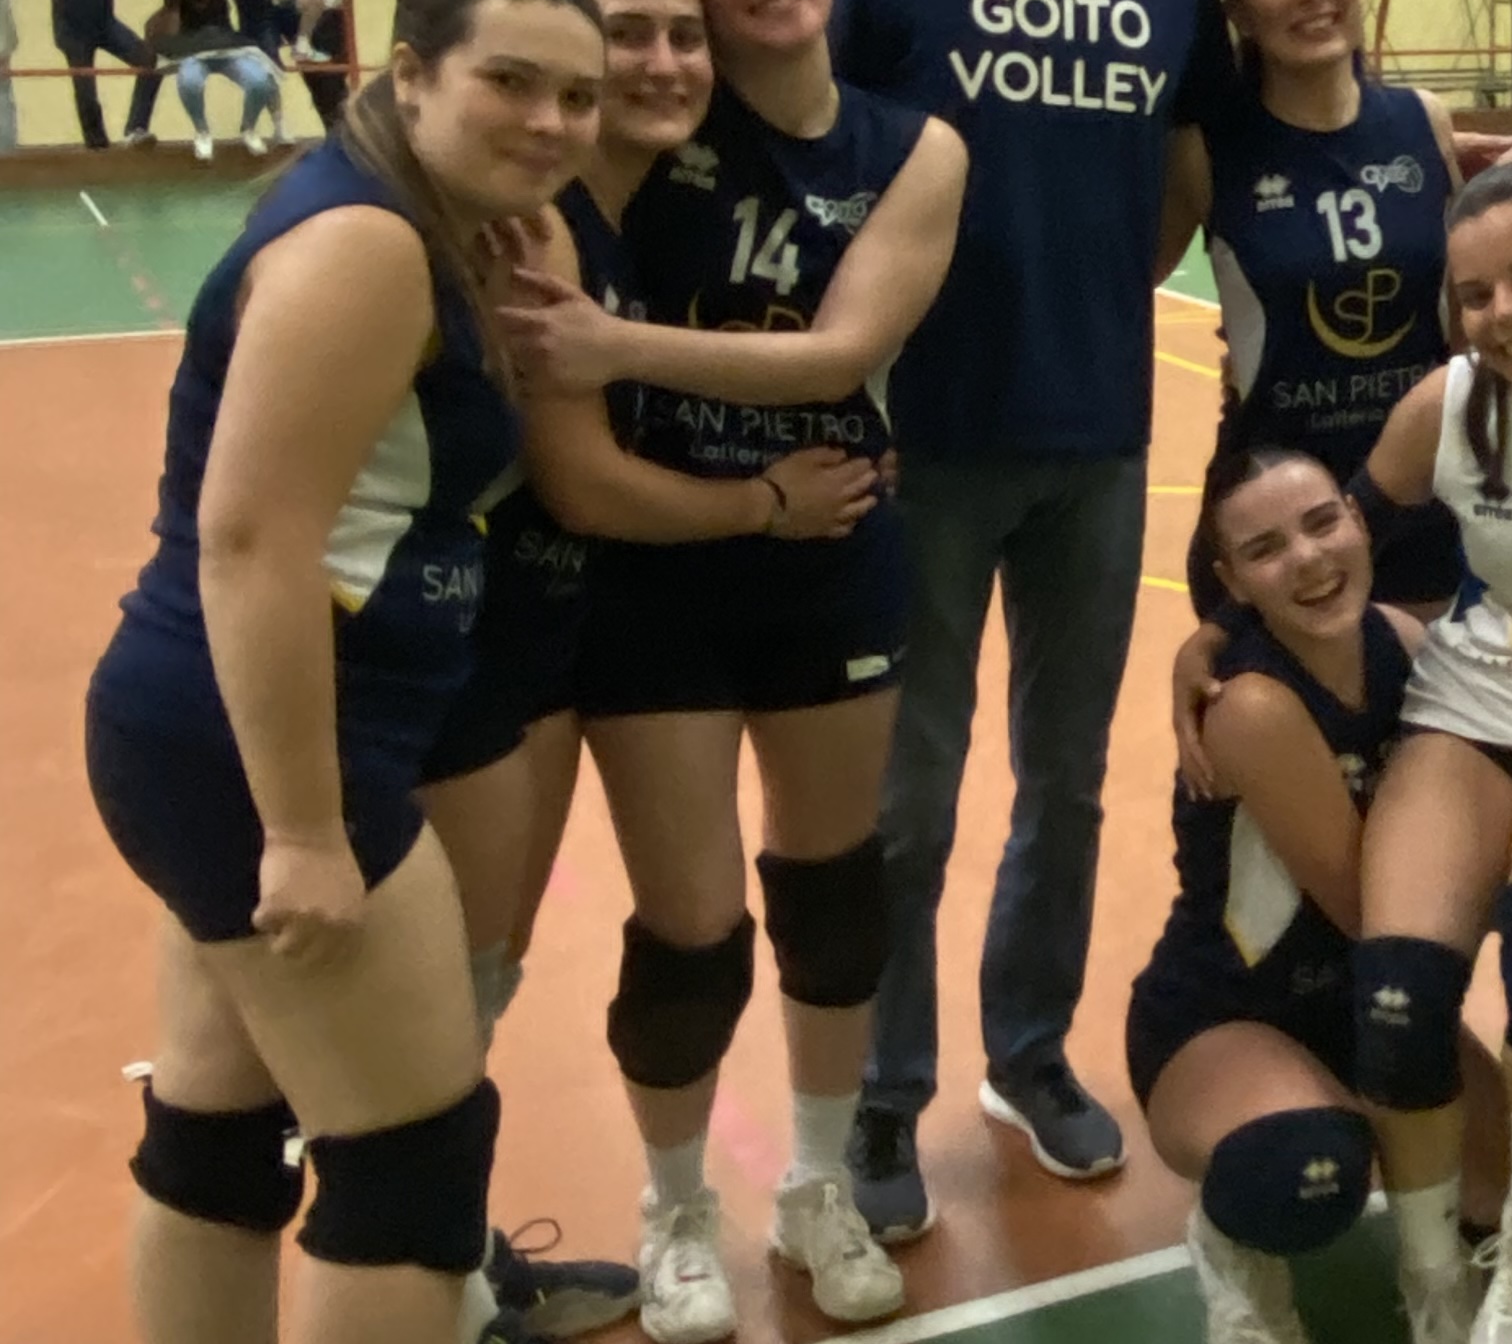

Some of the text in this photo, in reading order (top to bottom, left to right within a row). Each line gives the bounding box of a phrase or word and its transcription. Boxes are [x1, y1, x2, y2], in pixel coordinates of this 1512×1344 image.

[948, 49, 1167, 116] VOLLEY
[729, 195, 800, 295] 14
[1316, 187, 1383, 263] 13
[1271, 360, 1434, 409] SAN PIETR
[674, 399, 865, 444] AN PIETRO
[421, 563, 479, 603] SAN
